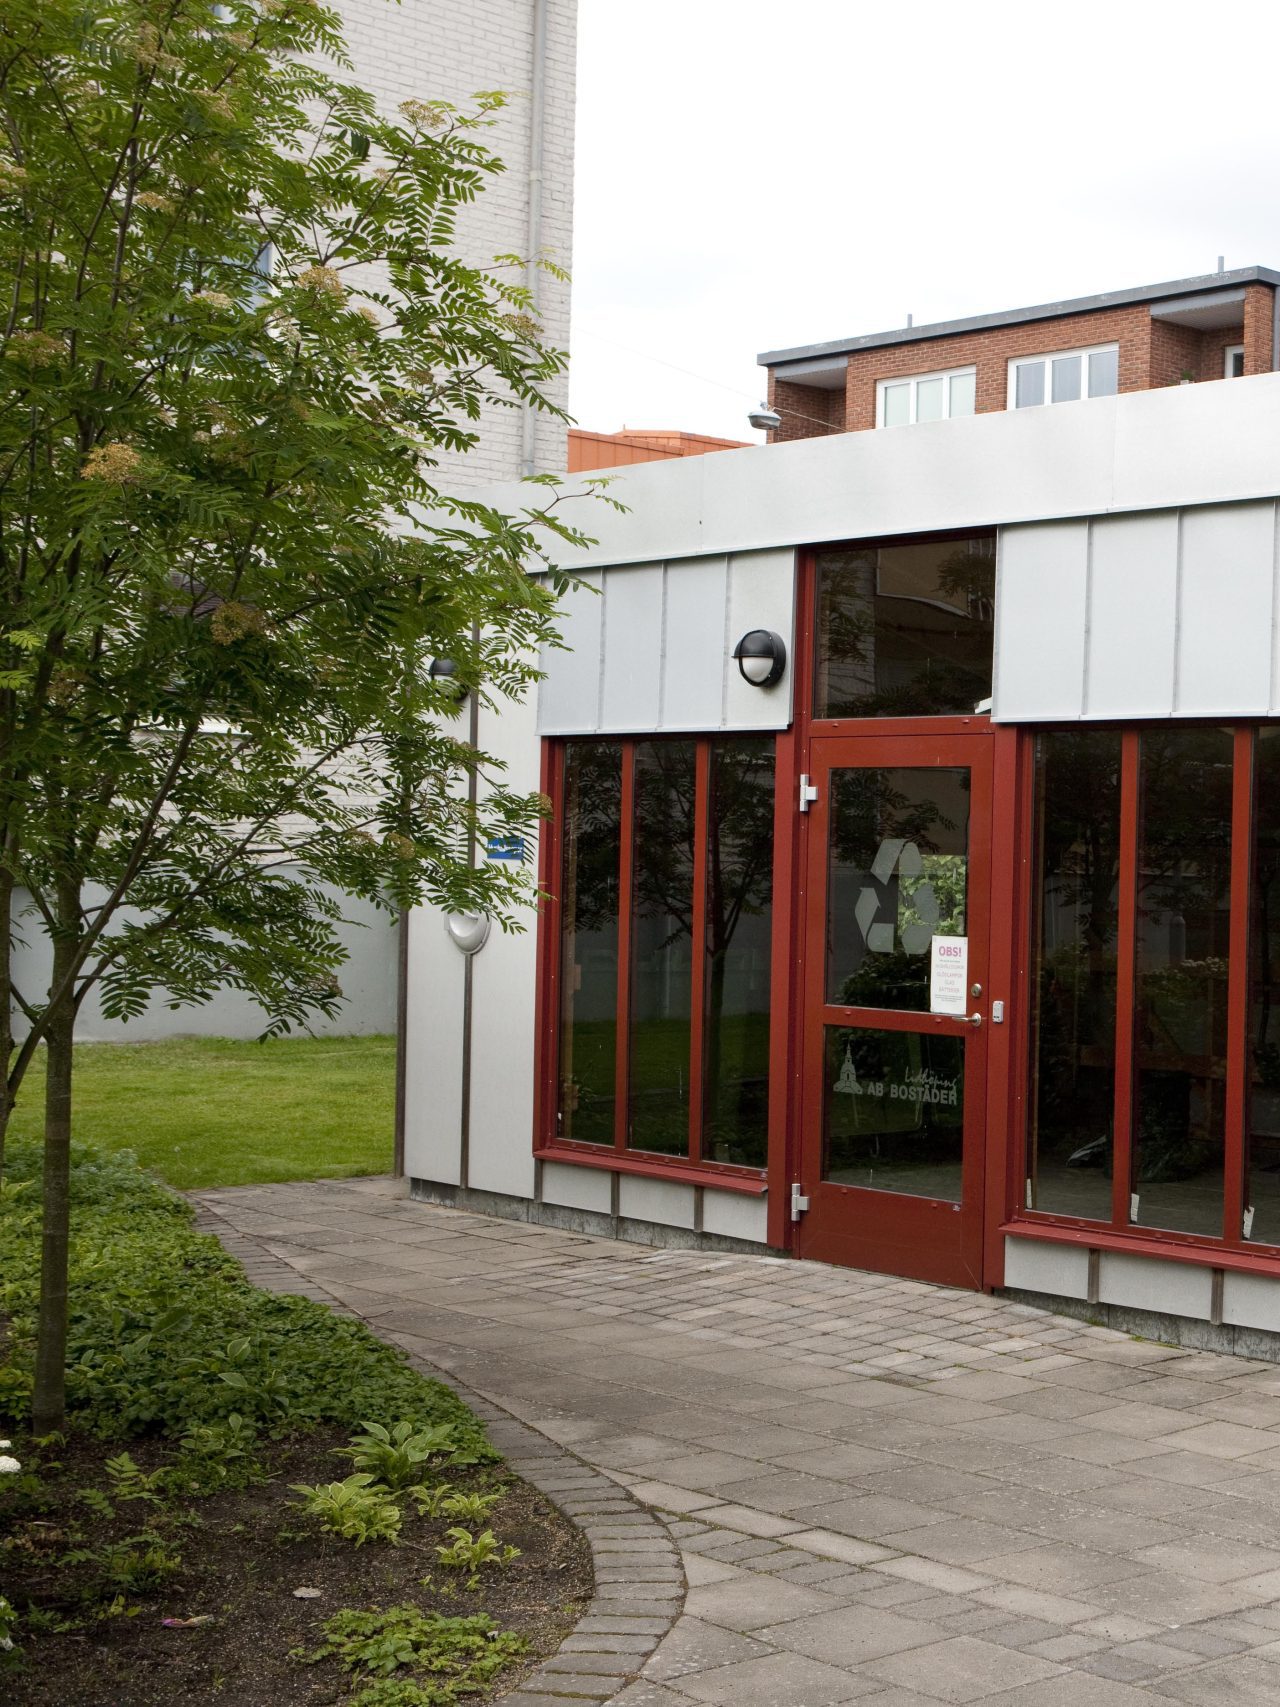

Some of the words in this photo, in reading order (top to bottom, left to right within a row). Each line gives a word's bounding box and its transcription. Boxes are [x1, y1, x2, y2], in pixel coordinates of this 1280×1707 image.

[938, 945, 962, 958] OBS!
[867, 1081, 884, 1097] AB
[890, 1083, 958, 1106] BOSTÄDER
